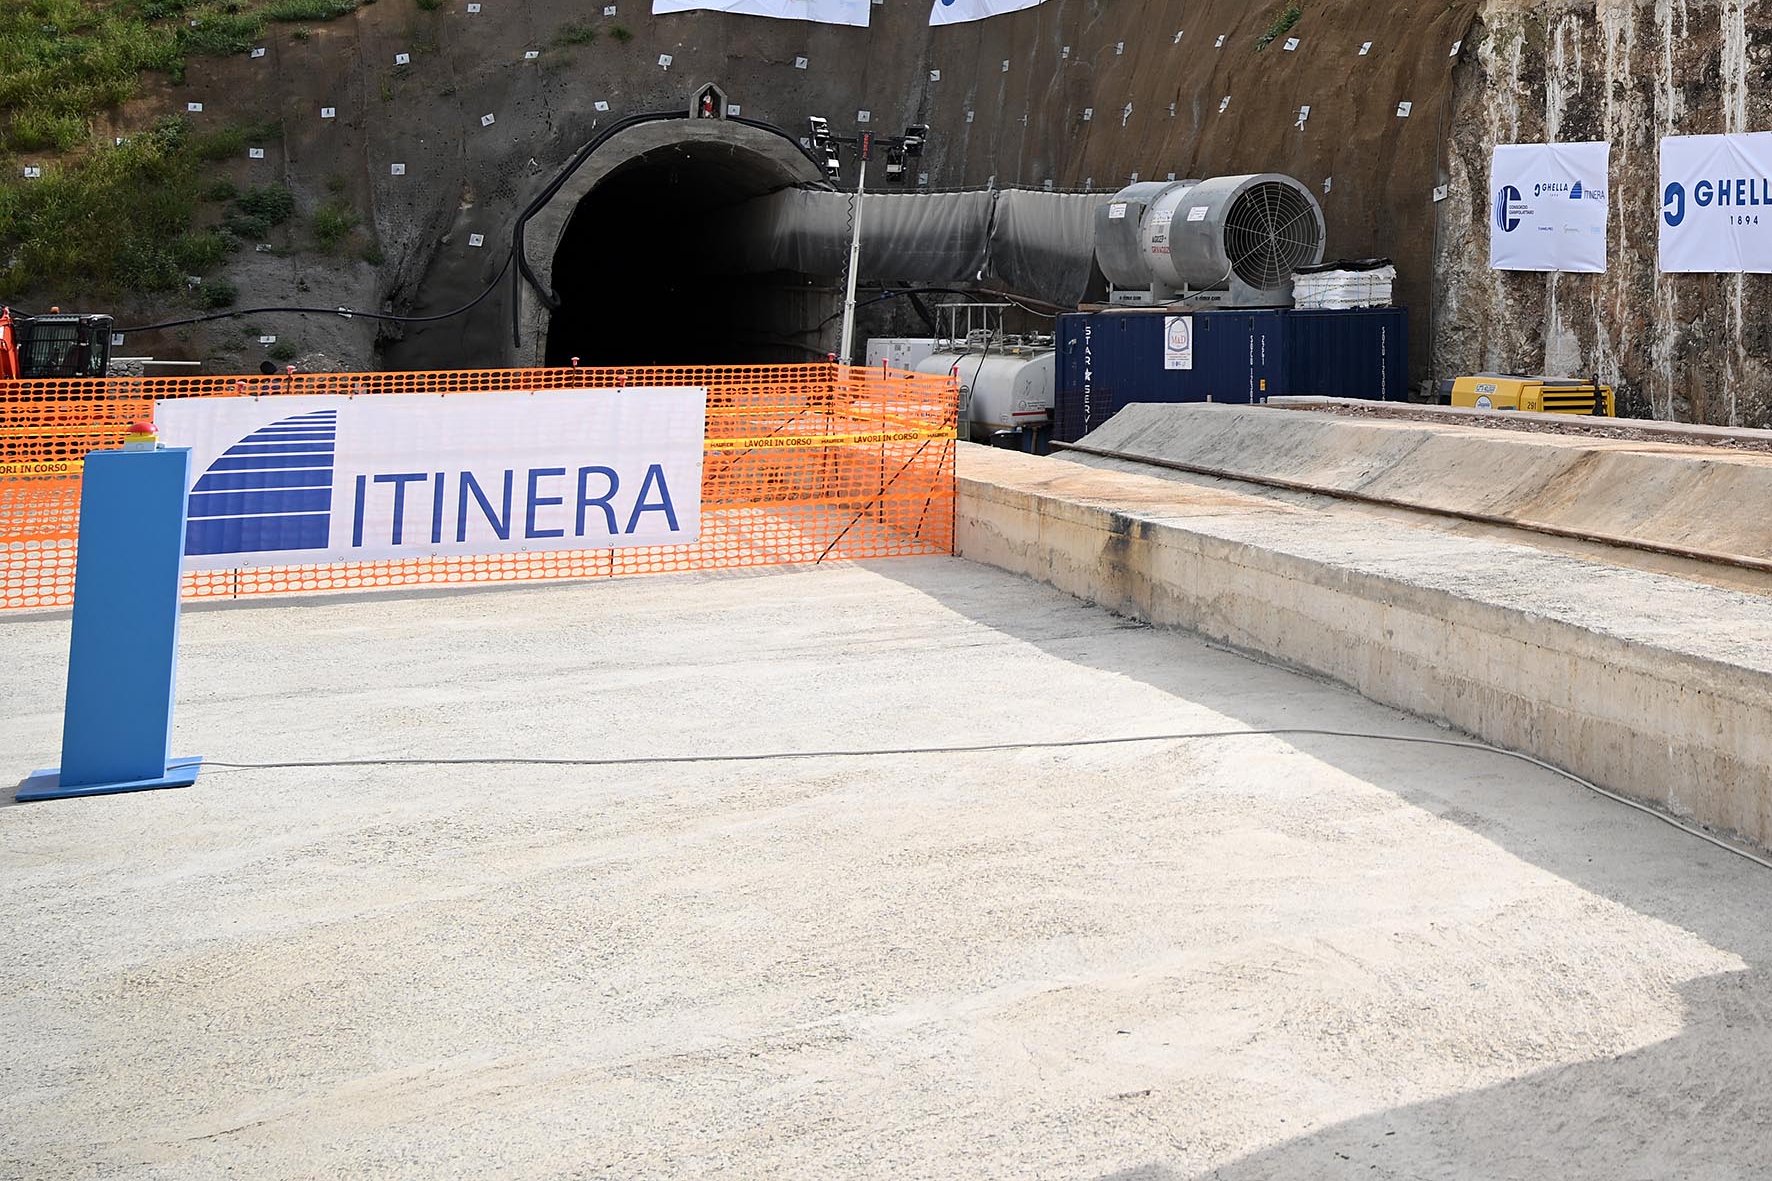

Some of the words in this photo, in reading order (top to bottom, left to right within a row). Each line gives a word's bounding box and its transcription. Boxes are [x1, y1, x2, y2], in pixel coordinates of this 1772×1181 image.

[1541, 183, 1569, 191] GHELLA
[1583, 189, 1605, 200] ITINERA
[1730, 215, 1759, 226] 1894
[1084, 326, 1092, 365] STAR
[1527, 402, 1537, 410] 291
[744, 439, 774, 447] LAVORI
[775, 439, 784, 447] IN
[786, 438, 812, 446] CORSO
[853, 435, 881, 443] LAVORI
[883, 434, 892, 442] IN
[894, 433, 918, 441] CORSO
[20, 465, 32, 473] IN
[34, 463, 68, 473] CORSO
[352, 463, 681, 548] ITINERA
